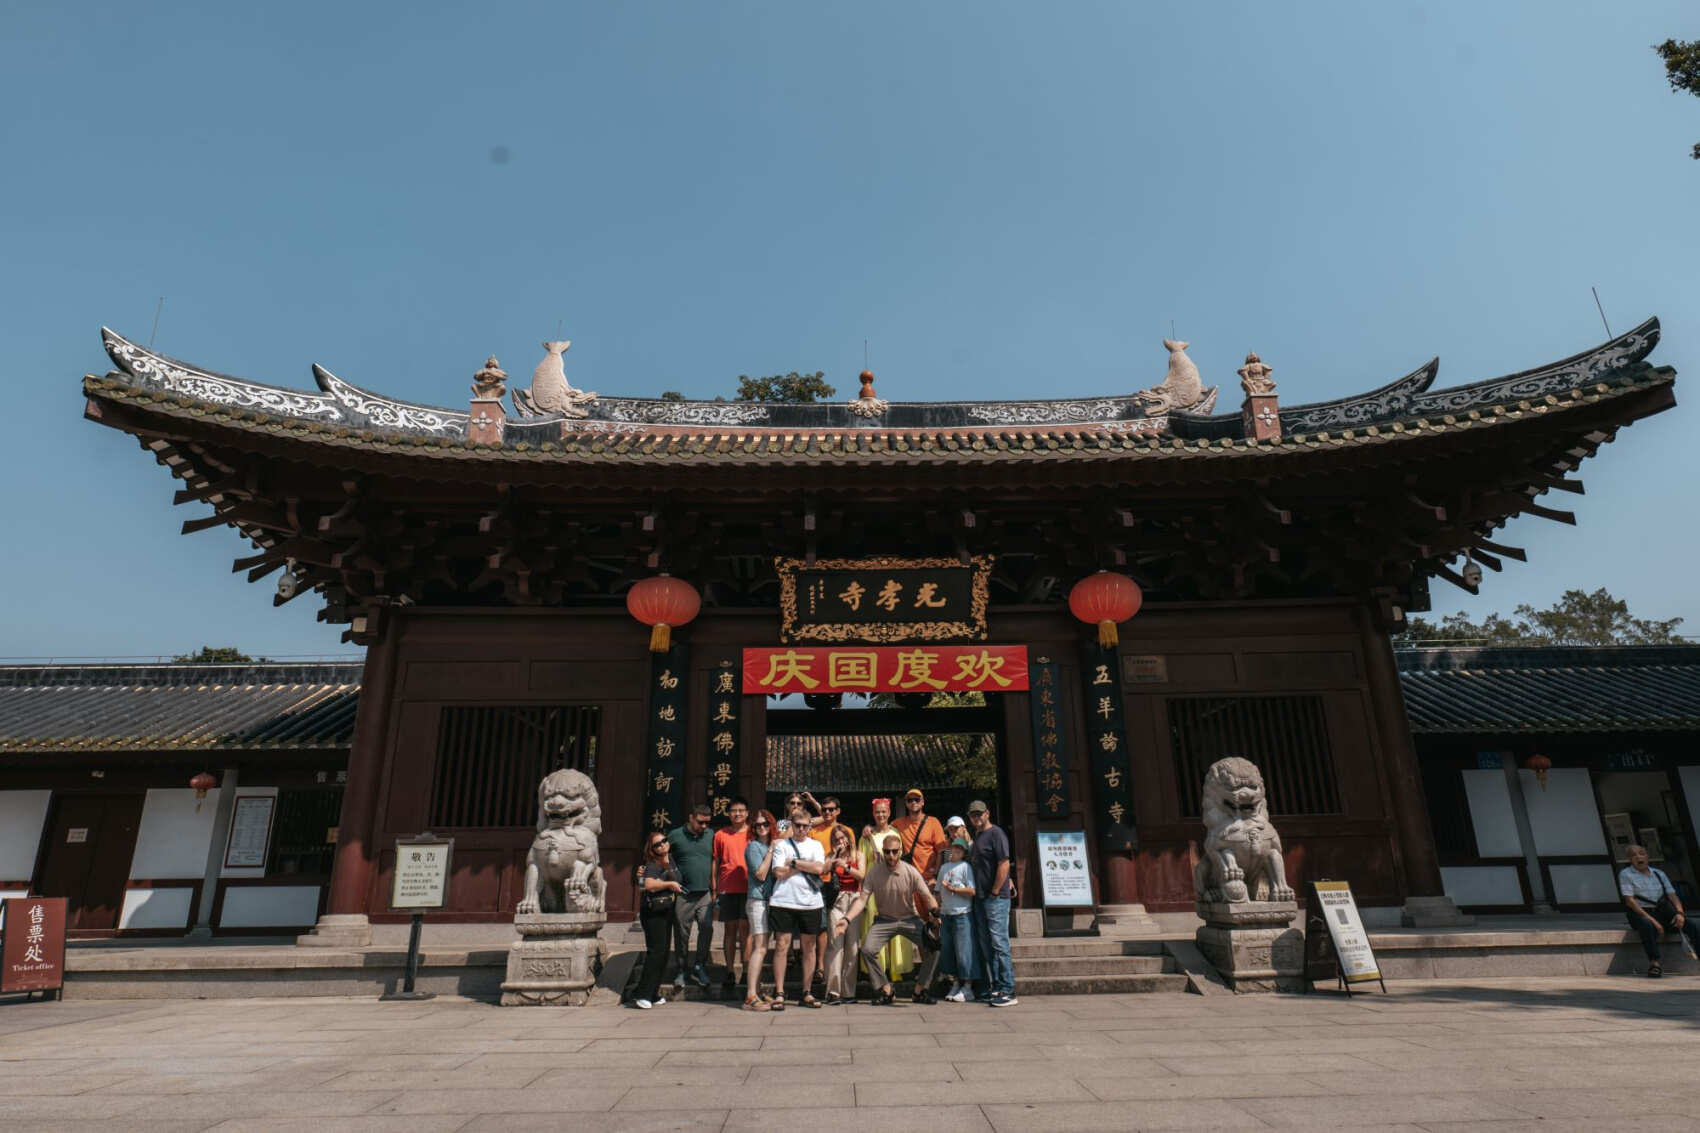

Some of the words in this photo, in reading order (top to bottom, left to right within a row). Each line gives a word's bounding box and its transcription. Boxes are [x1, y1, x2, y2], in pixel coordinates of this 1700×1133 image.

[838, 579, 947, 611] 光孝寺
[759, 649, 1013, 689] 欢度国庆
[24, 904, 45, 962] 售票处
